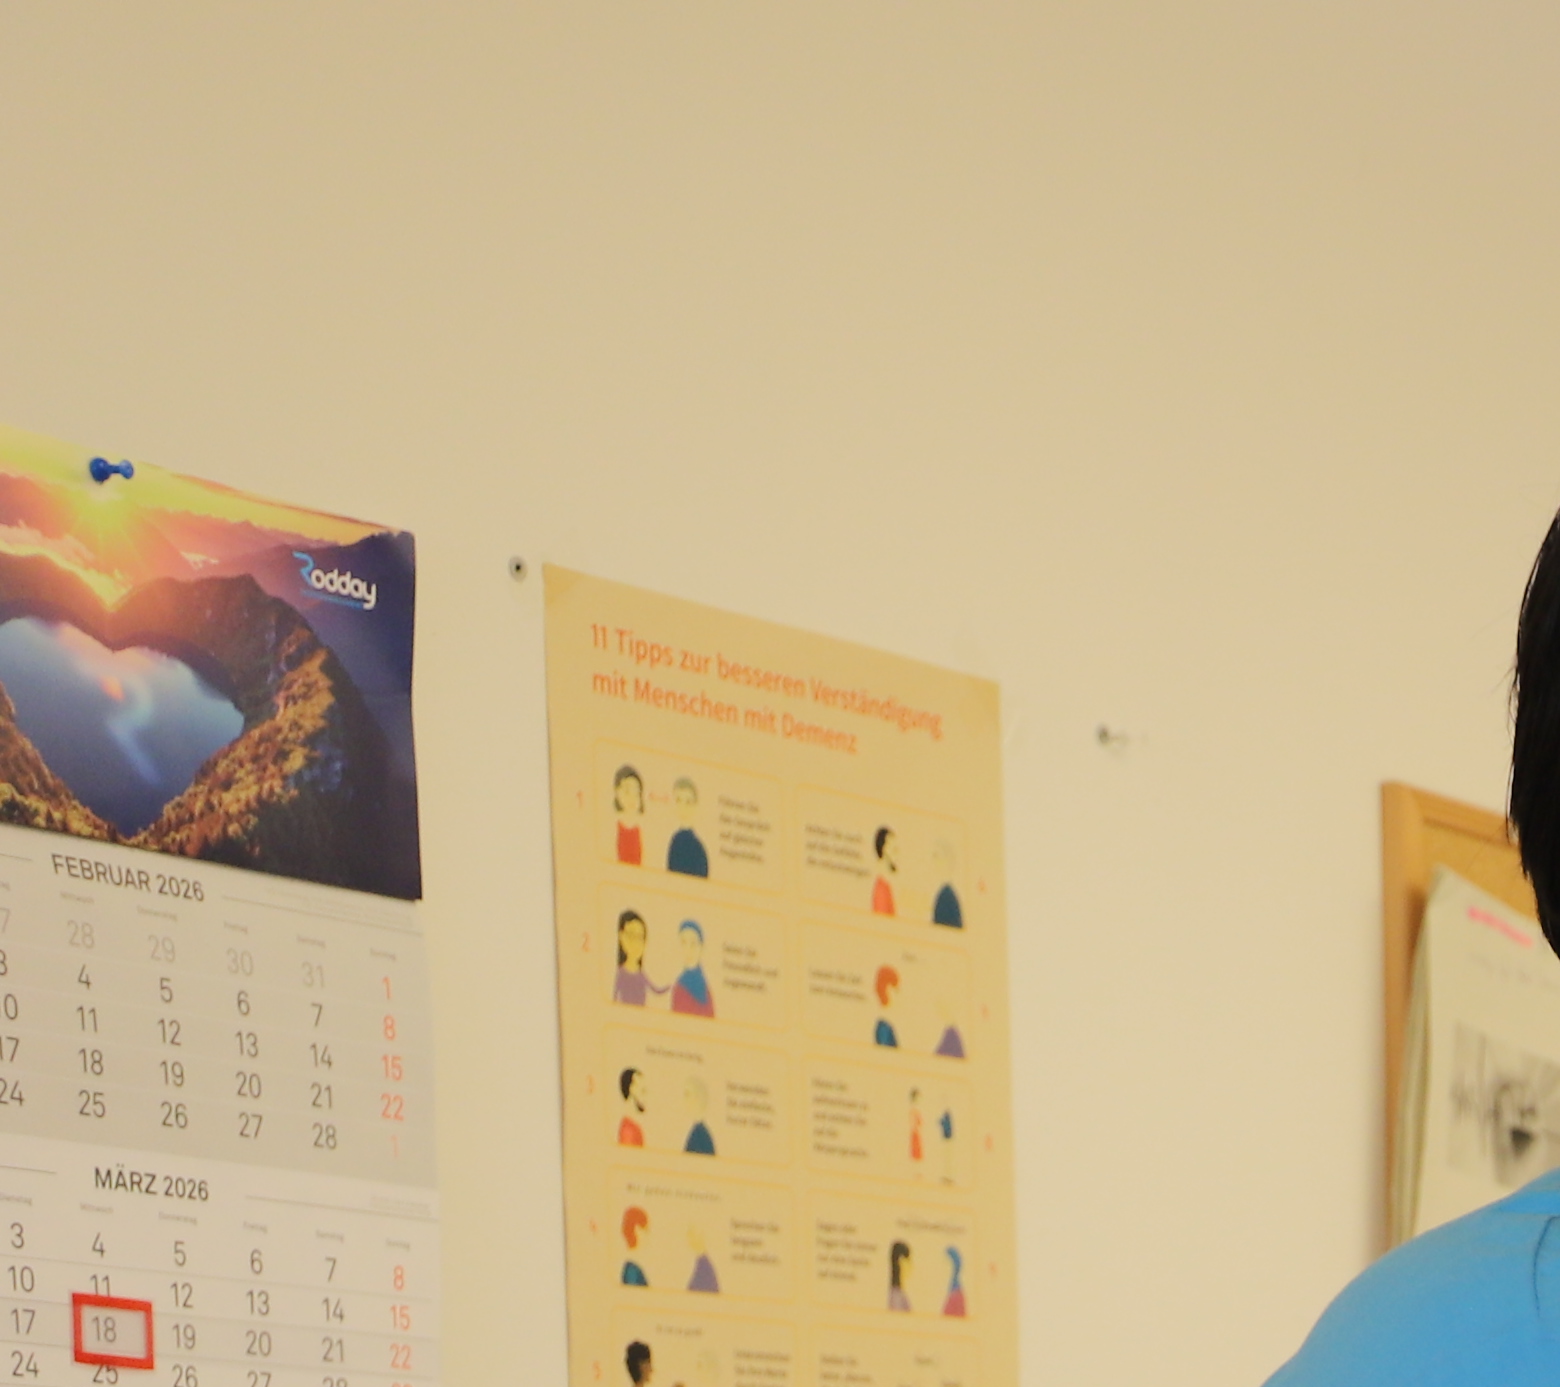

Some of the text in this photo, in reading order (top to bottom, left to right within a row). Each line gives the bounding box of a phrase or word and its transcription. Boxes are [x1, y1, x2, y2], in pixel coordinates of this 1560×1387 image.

[292, 550, 377, 611] Rodday
[590, 622, 944, 742] 11 Tipps zur besseren Verständigung
[591, 669, 859, 756] mit Menschen mit Demenz
[51, 852, 204, 902] FEBRUAR 2026
[66, 920, 95, 950] 28
[148, 934, 176, 964] 29
[226, 948, 255, 977] 30
[301, 961, 326, 989] 31
[382, 976, 392, 1000] 1
[581, 932, 591, 953] 2
[78, 965, 92, 990] 4
[160, 977, 173, 1004] 5
[237, 990, 250, 1017] 6
[311, 1002, 323, 1027] 7
[383, 1015, 396, 1041] 8
[77, 1005, 98, 1033] 11
[158, 1018, 181, 1047] 12
[235, 1031, 259, 1059] 13
[310, 1043, 333, 1069] 14
[382, 1054, 403, 1082] 15
[79, 1048, 104, 1077] 18
[160, 1060, 185, 1088] 19
[236, 1071, 262, 1099] 20
[311, 1082, 333, 1109] 21
[381, 1093, 404, 1122] 22
[79, 1089, 106, 1119] 25
[161, 1101, 188, 1129] 26
[239, 1112, 263, 1139] 27
[312, 1122, 337, 1151] 28
[94, 1163, 209, 1202] MÄRZ 2026
[10, 1222, 405, 1291] 3 4 5 6 7 8
[8, 1265, 411, 1331] 10 11 12 13 14 15
[11, 1308, 411, 1371] 17 18 19 20 21 22
[11, 1350, 39, 1378] 24
[92, 1364, 120, 1386] 25
